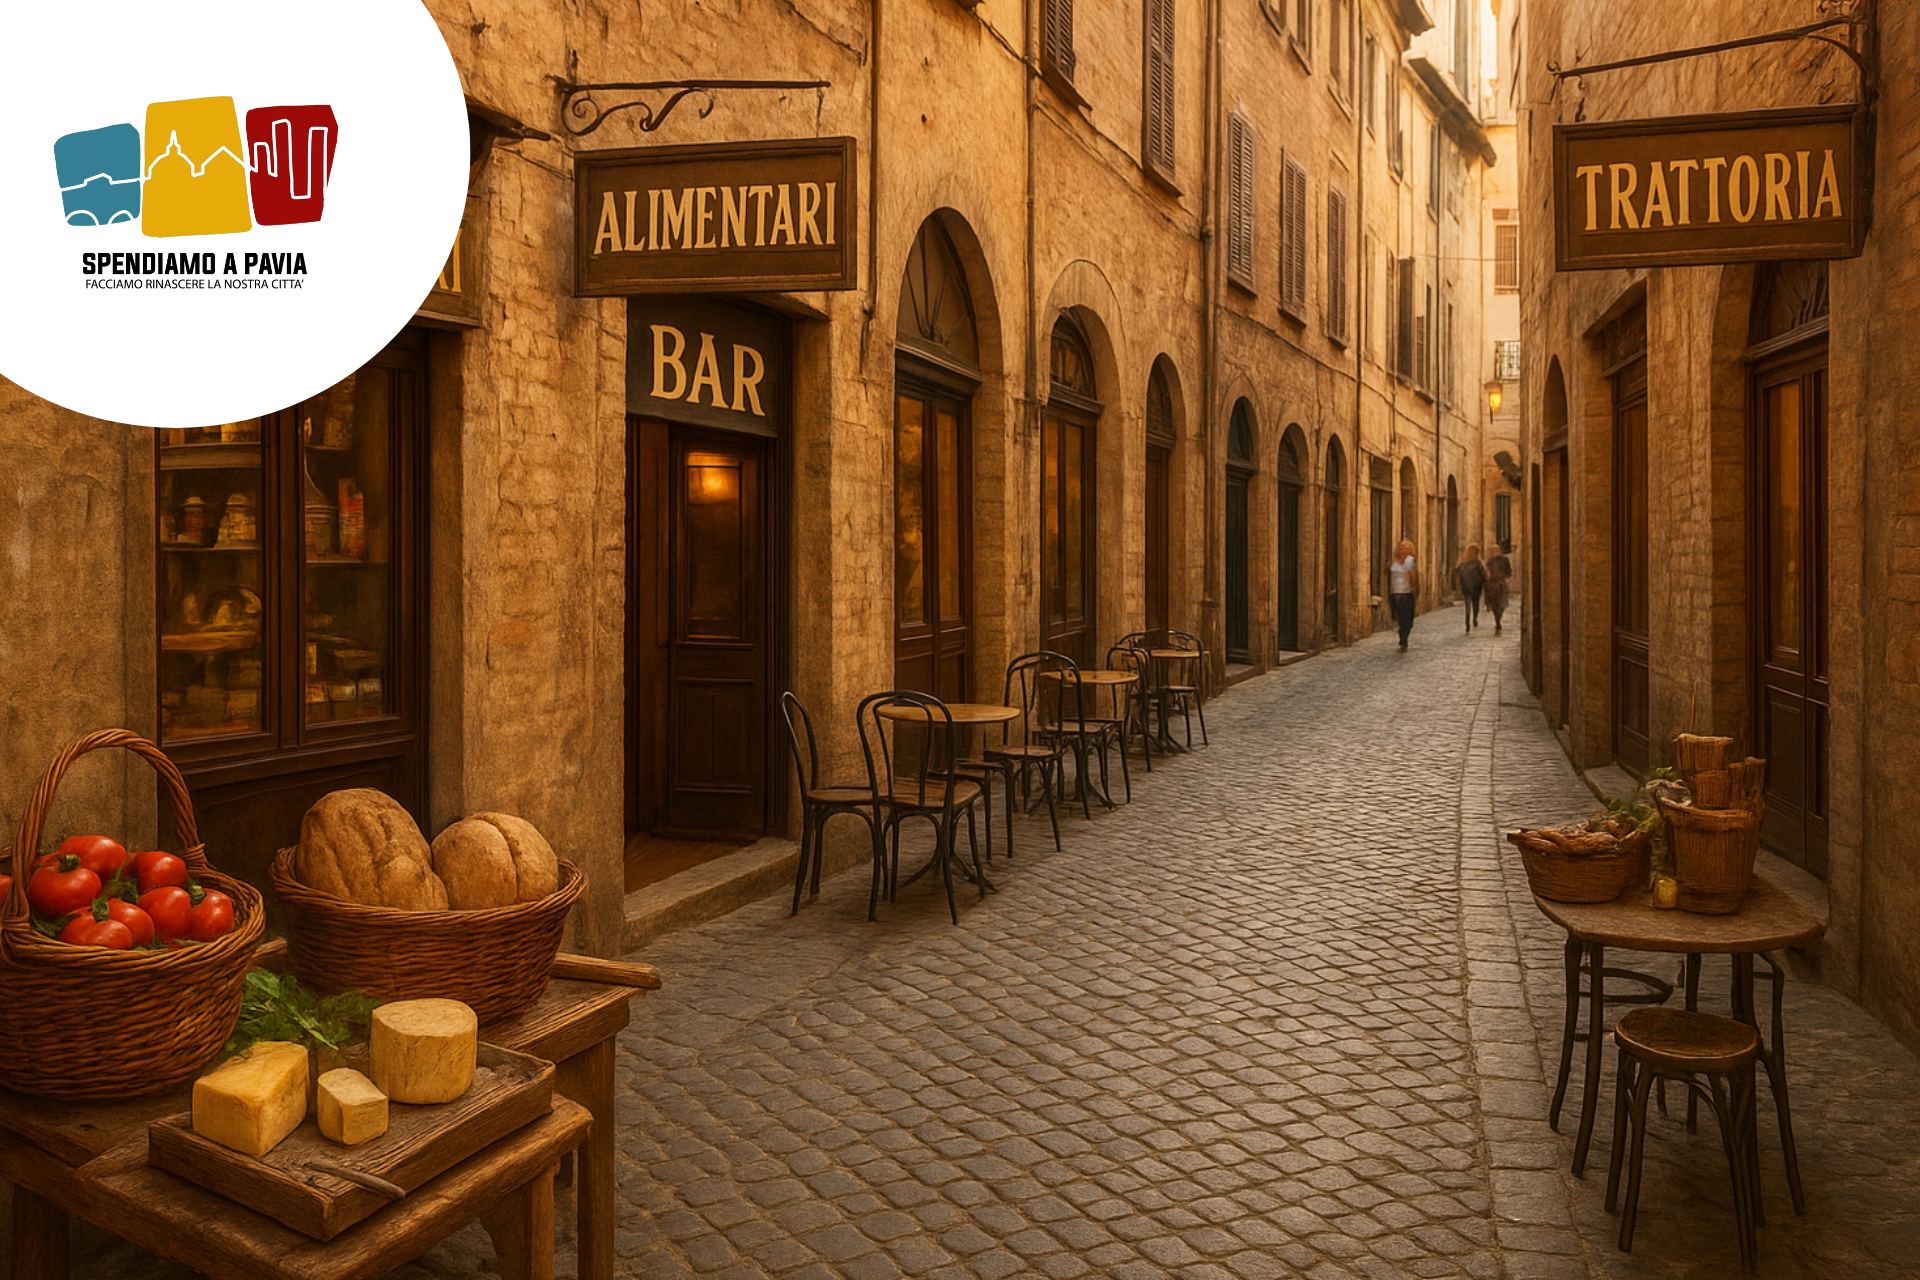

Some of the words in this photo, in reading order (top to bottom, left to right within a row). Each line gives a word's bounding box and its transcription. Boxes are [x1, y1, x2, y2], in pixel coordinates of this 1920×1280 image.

[593, 181, 837, 255] ALIMENTARI
[1576, 149, 1842, 231] TRATTORIA
[650, 324, 765, 416] BAR
